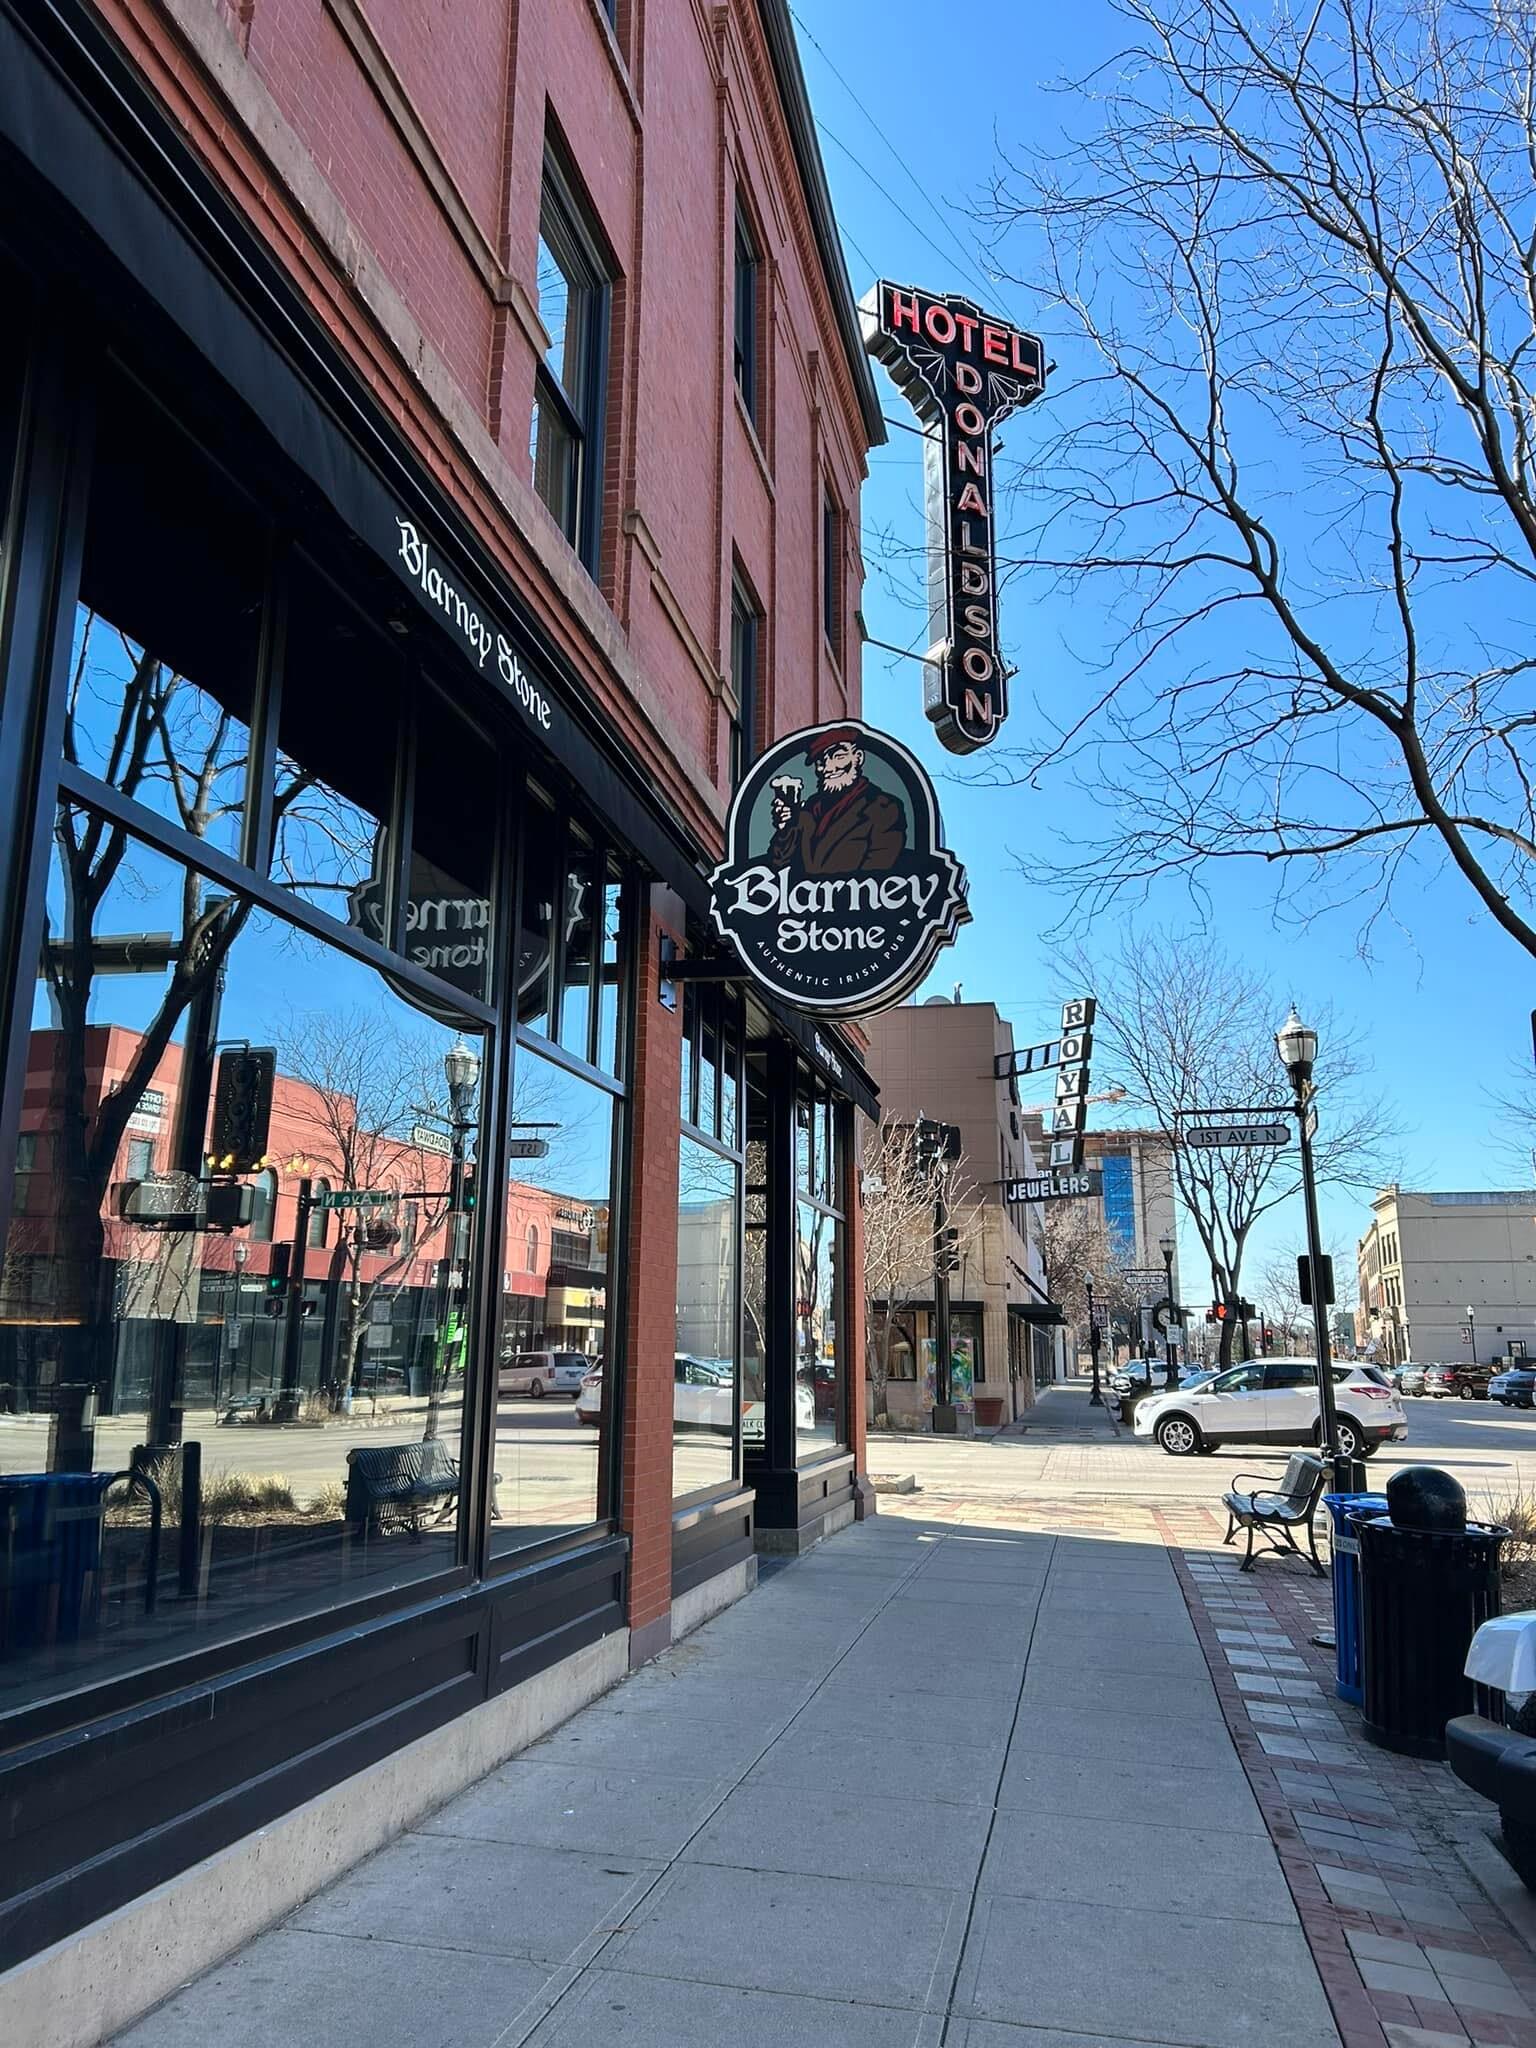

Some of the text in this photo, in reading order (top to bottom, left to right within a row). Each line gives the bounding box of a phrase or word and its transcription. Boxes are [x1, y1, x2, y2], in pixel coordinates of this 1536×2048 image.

[891, 291, 1037, 376] HOTEL
[954, 360, 992, 725] DONALDSON
[396, 516, 551, 730] Blarney Stone
[724, 865, 940, 920] Blarney
[756, 934, 905, 986] AUTHENTIC IRISH PUB
[776, 918, 886, 954] Stone
[1053, 1001, 1083, 1164] ROYAL
[1200, 1129, 1277, 1143] 1ST AVE N
[1008, 1175, 1090, 1201] JEWELERS
